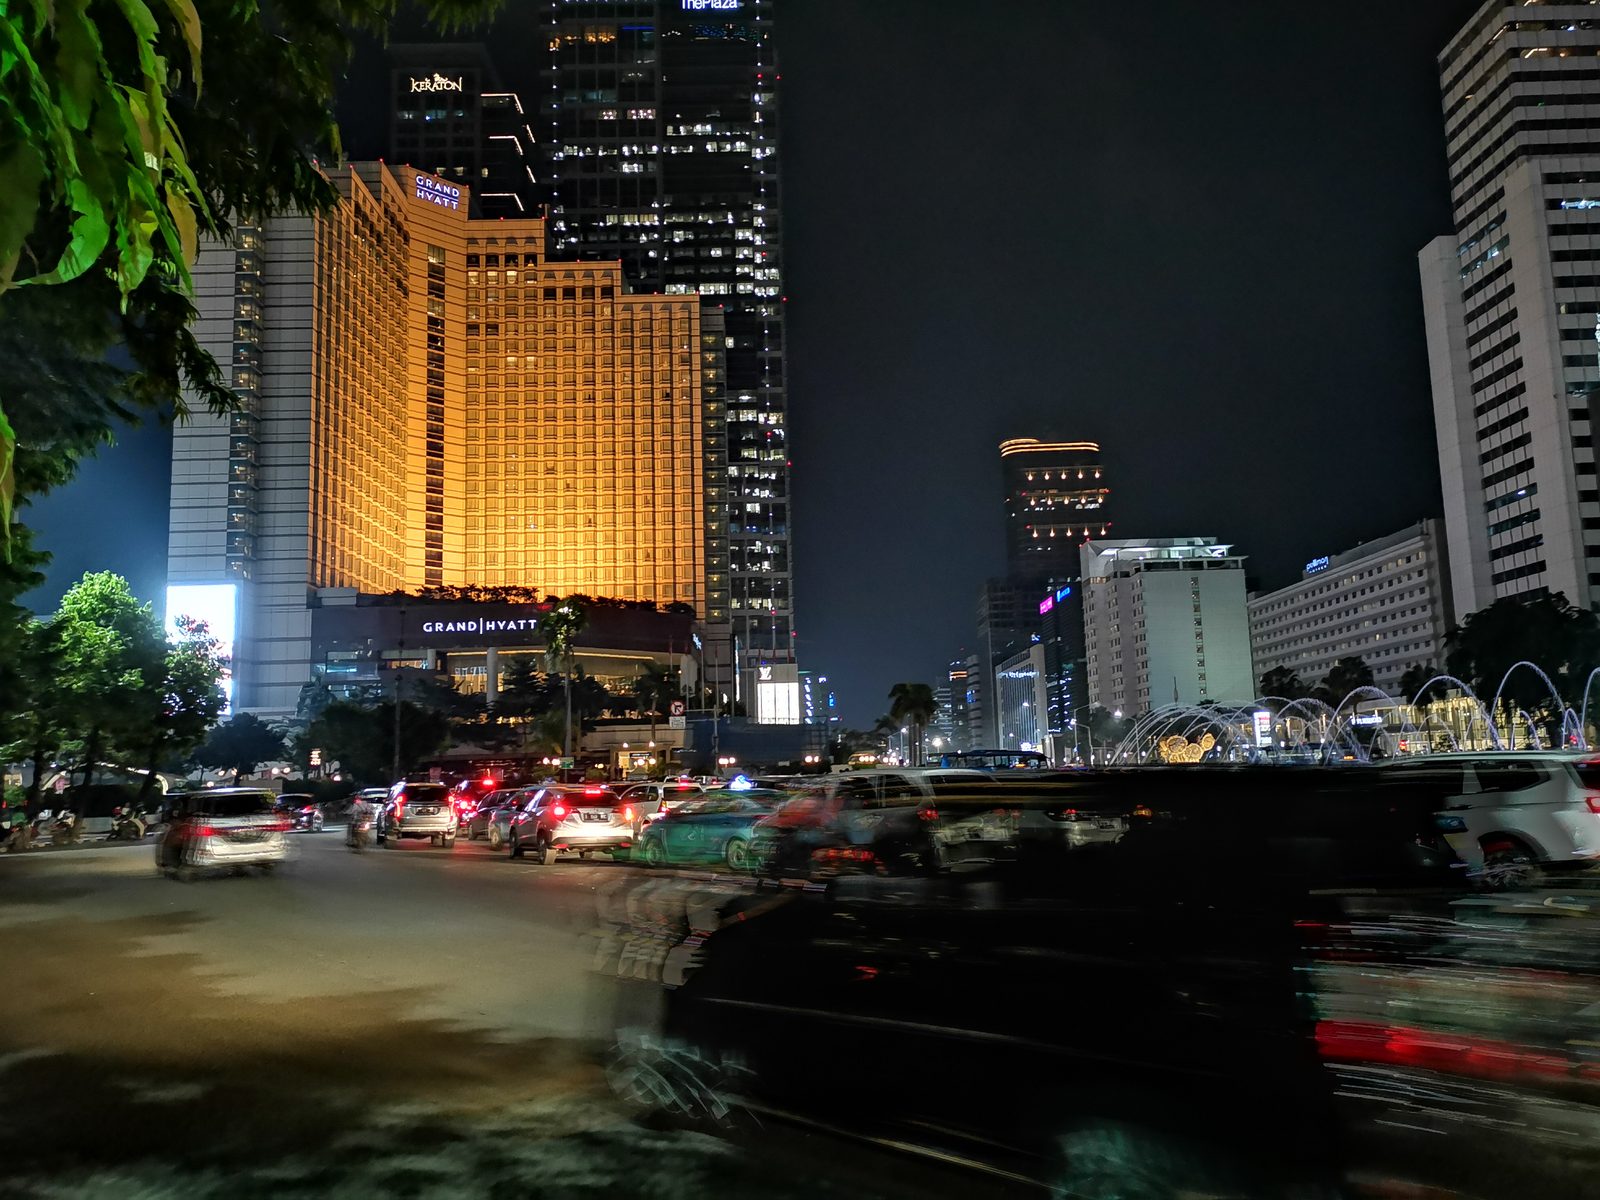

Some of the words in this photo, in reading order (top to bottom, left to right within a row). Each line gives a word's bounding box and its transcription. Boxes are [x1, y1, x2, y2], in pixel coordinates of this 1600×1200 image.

[410, 76, 463, 92] KERATON
[416, 175, 460, 197] GRAND
[416, 189, 459, 210] HYATT
[422, 621, 478, 633] GRAND
[485, 619, 538, 631] HYATT
